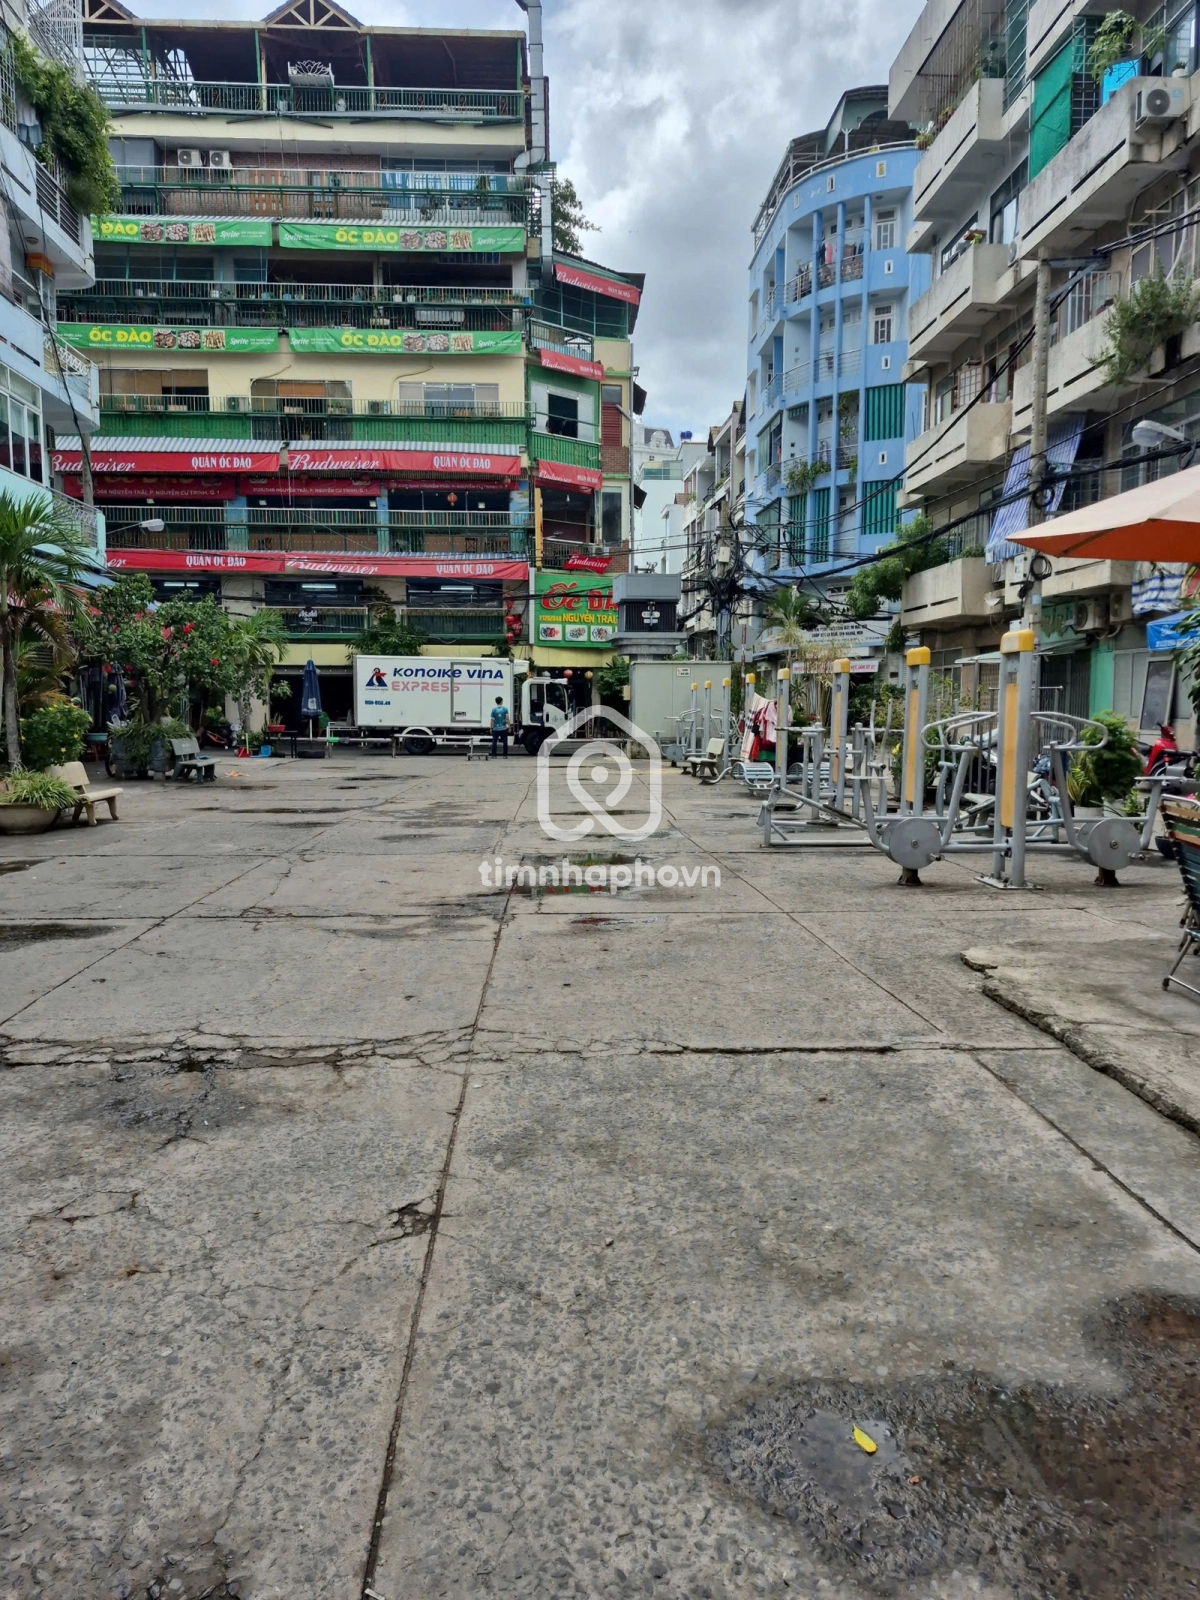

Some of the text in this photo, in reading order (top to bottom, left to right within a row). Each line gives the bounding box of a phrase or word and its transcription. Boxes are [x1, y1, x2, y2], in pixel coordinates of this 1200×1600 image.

[220, 230, 240, 239] Sprite
[335, 226, 358, 243] ỐC
[362, 228, 399, 244] ĐÀO
[477, 237, 496, 246] Sprite
[556, 270, 604, 293] Budweiser
[89, 326, 112, 342] ỐC
[116, 327, 152, 343] ĐÀO
[230, 337, 249, 346] Sprite
[290, 337, 310, 346] Sprite
[341, 330, 363, 346] ỐC
[367, 331, 402, 347] ĐÀO
[477, 339, 496, 348] Sprite
[219, 453, 232, 469] ỐC
[233, 454, 252, 469] ĐÀO
[288, 453, 380, 470] Budweiser
[459, 453, 471, 469] ỐC
[473, 456, 491, 470] ĐÀO
[284, 556, 379, 575] Budweiser
[568, 557, 608, 568] Budweiser
[391, 681, 460, 693] EXPRESS
